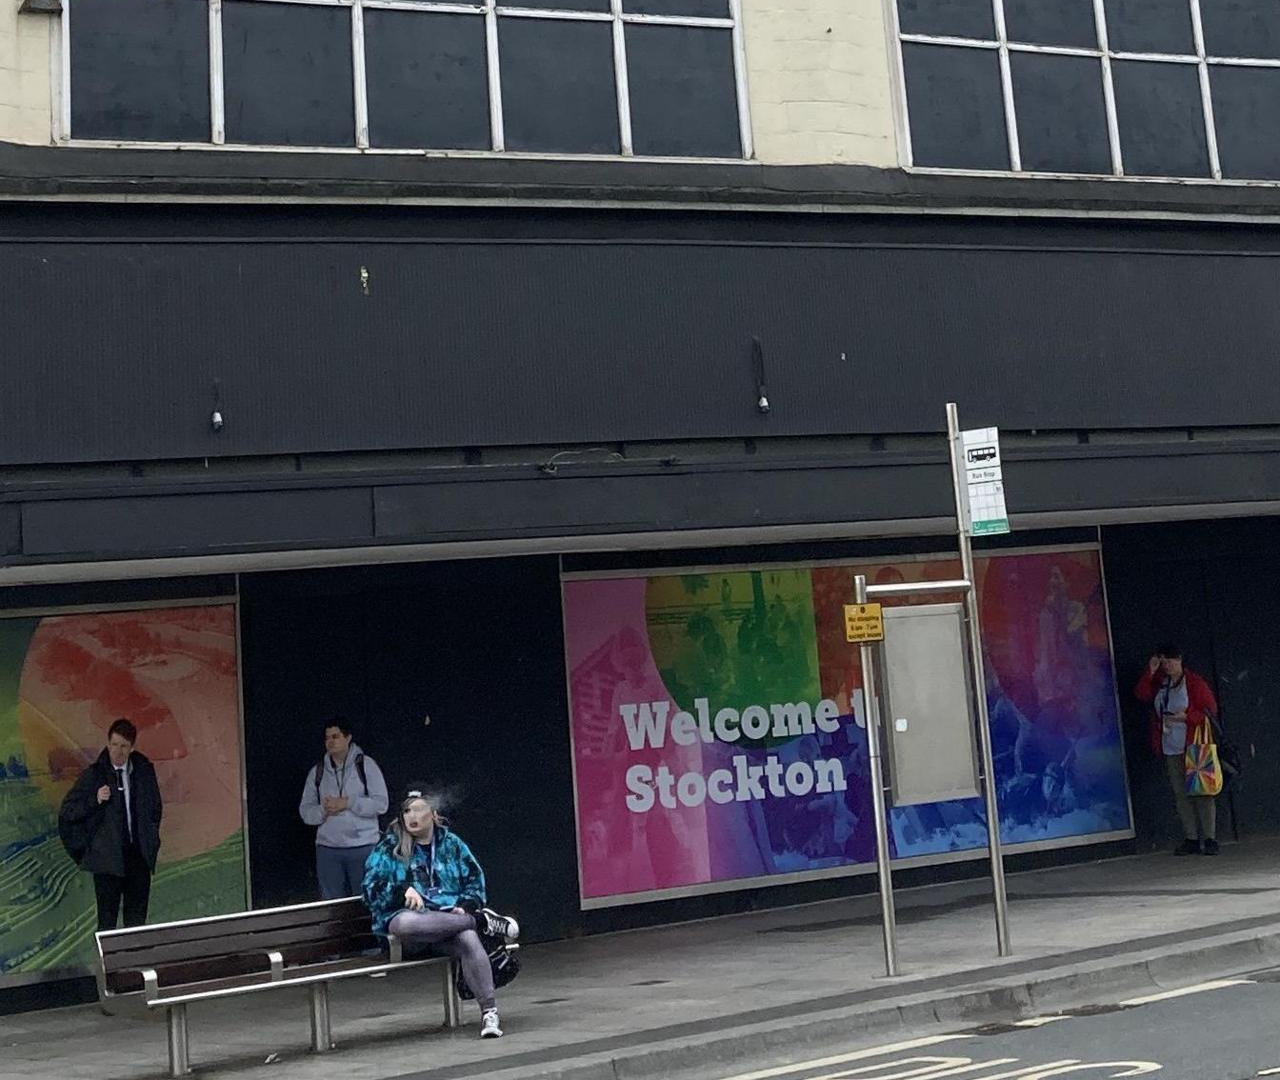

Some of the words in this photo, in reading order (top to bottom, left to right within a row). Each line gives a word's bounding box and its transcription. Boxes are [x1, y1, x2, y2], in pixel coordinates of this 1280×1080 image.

[620, 697, 840, 751] Welcome
[850, 688, 881, 728] t
[626, 755, 847, 812] Stockton
